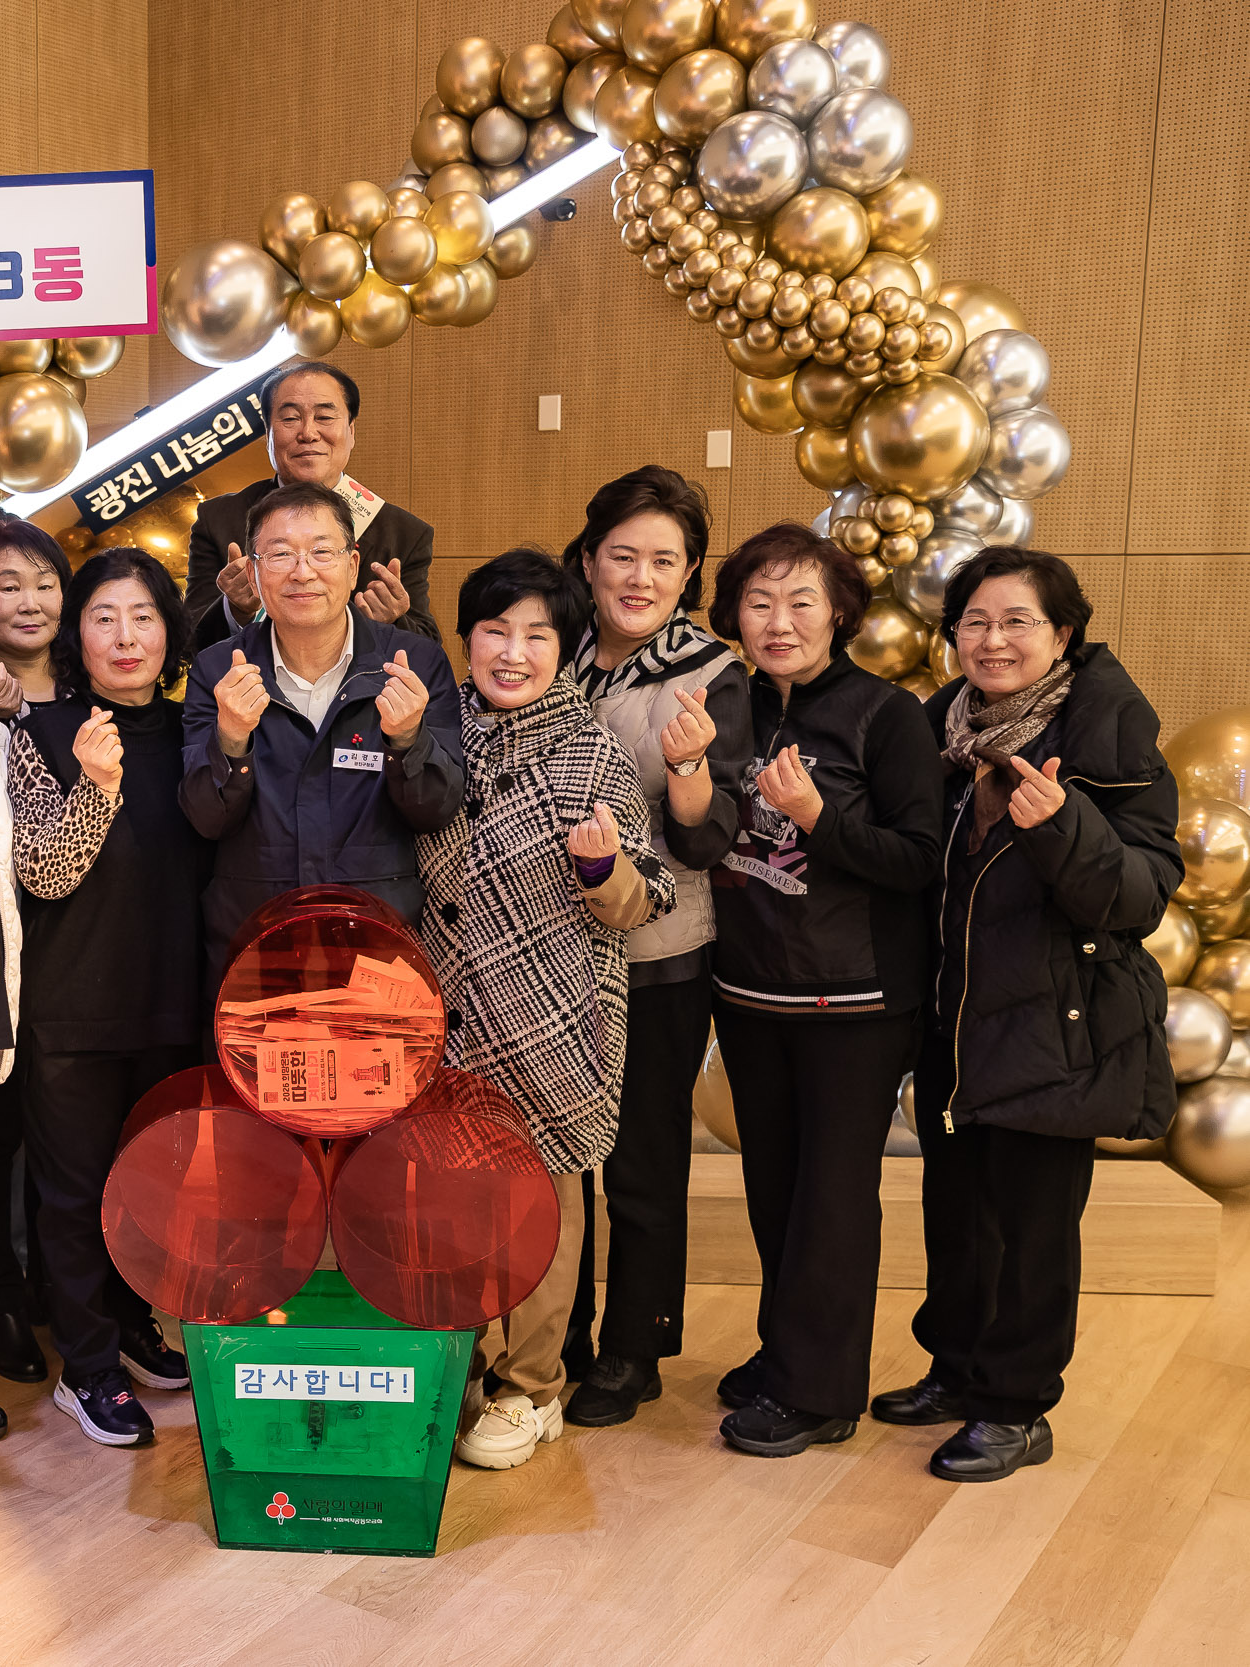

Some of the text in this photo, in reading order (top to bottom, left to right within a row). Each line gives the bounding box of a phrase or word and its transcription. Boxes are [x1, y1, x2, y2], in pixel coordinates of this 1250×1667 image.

[84, 402, 254, 521] 광진 나눔의
[290, 1050, 307, 1103] 따뜻한
